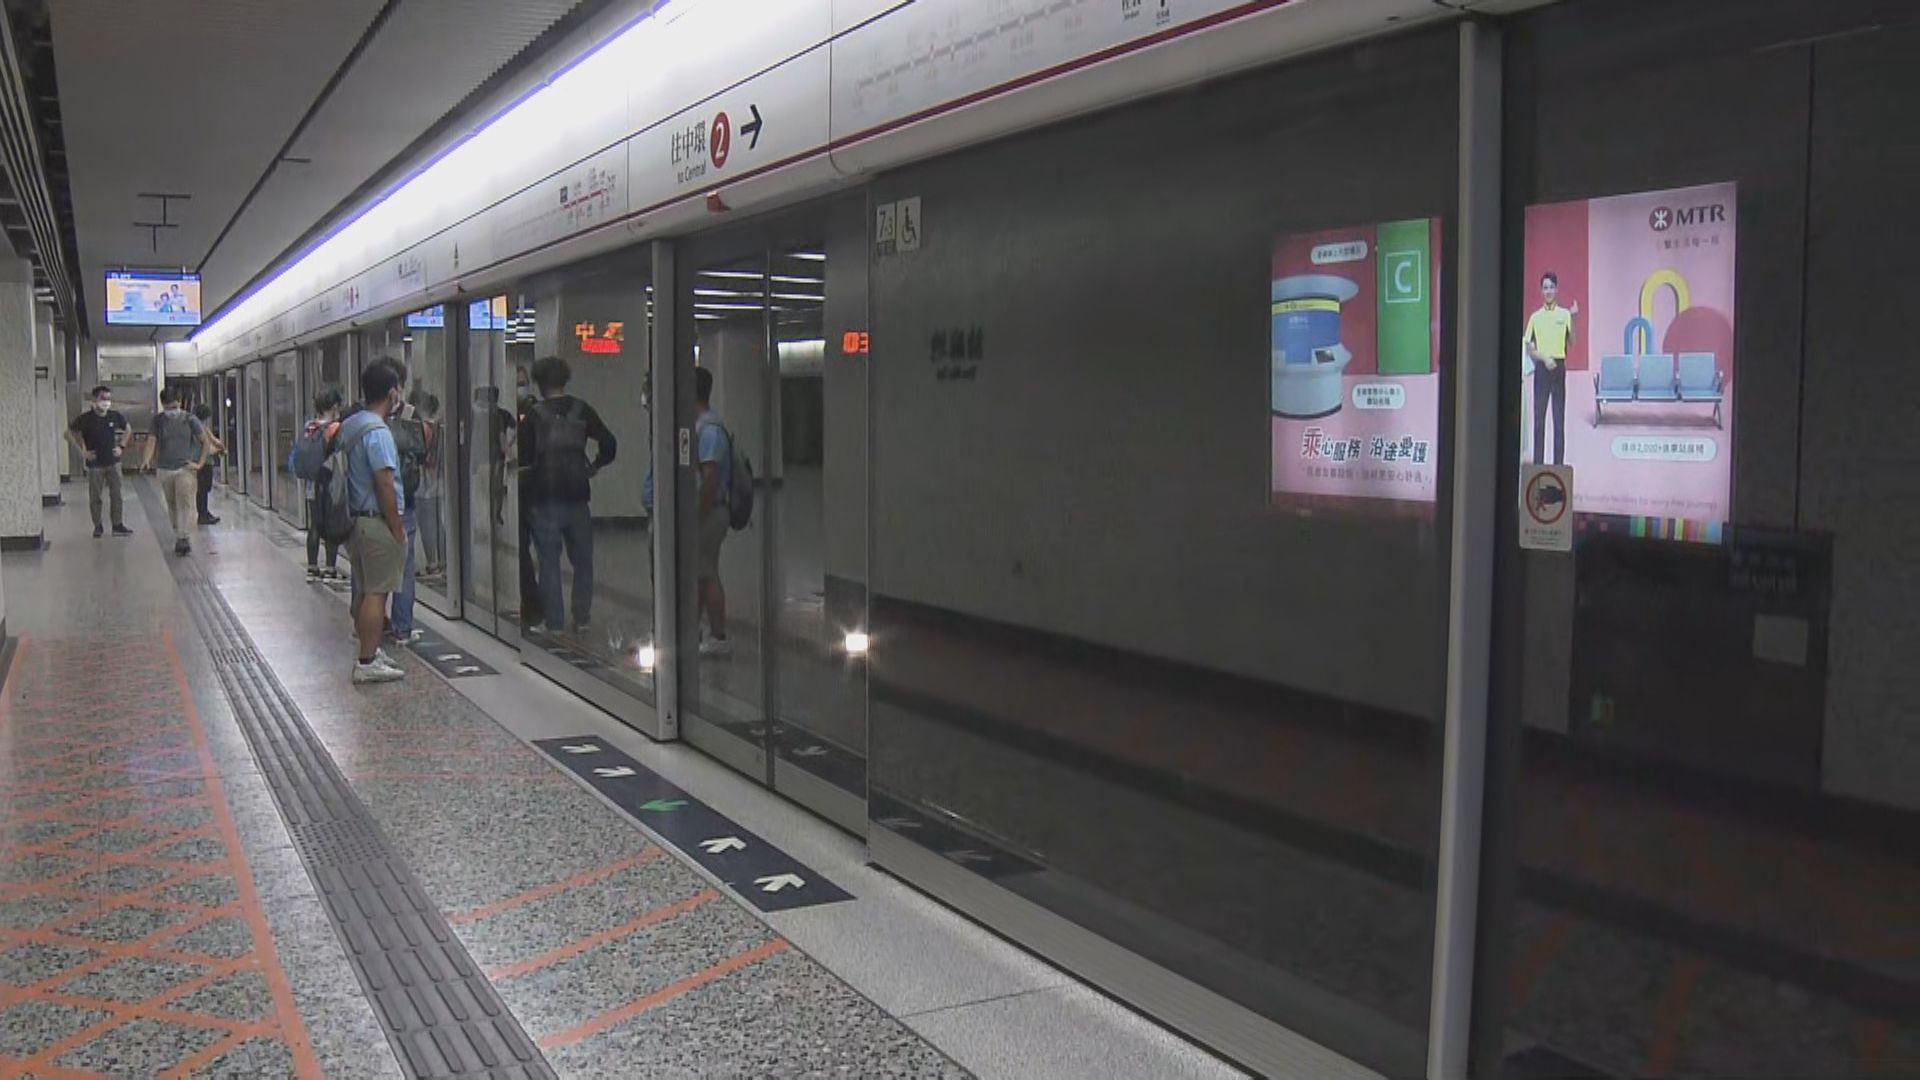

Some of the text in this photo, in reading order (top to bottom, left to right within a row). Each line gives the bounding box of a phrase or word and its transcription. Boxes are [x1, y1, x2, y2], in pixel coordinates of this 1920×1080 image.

[671, 120, 706, 166] 往中環
[715, 121, 725, 159] 2
[684, 158, 707, 181] Central
[1676, 204, 1726, 226] MTR
[1394, 260, 1412, 293] C
[1302, 427, 1428, 463] 乘心服務 沿途愛護
